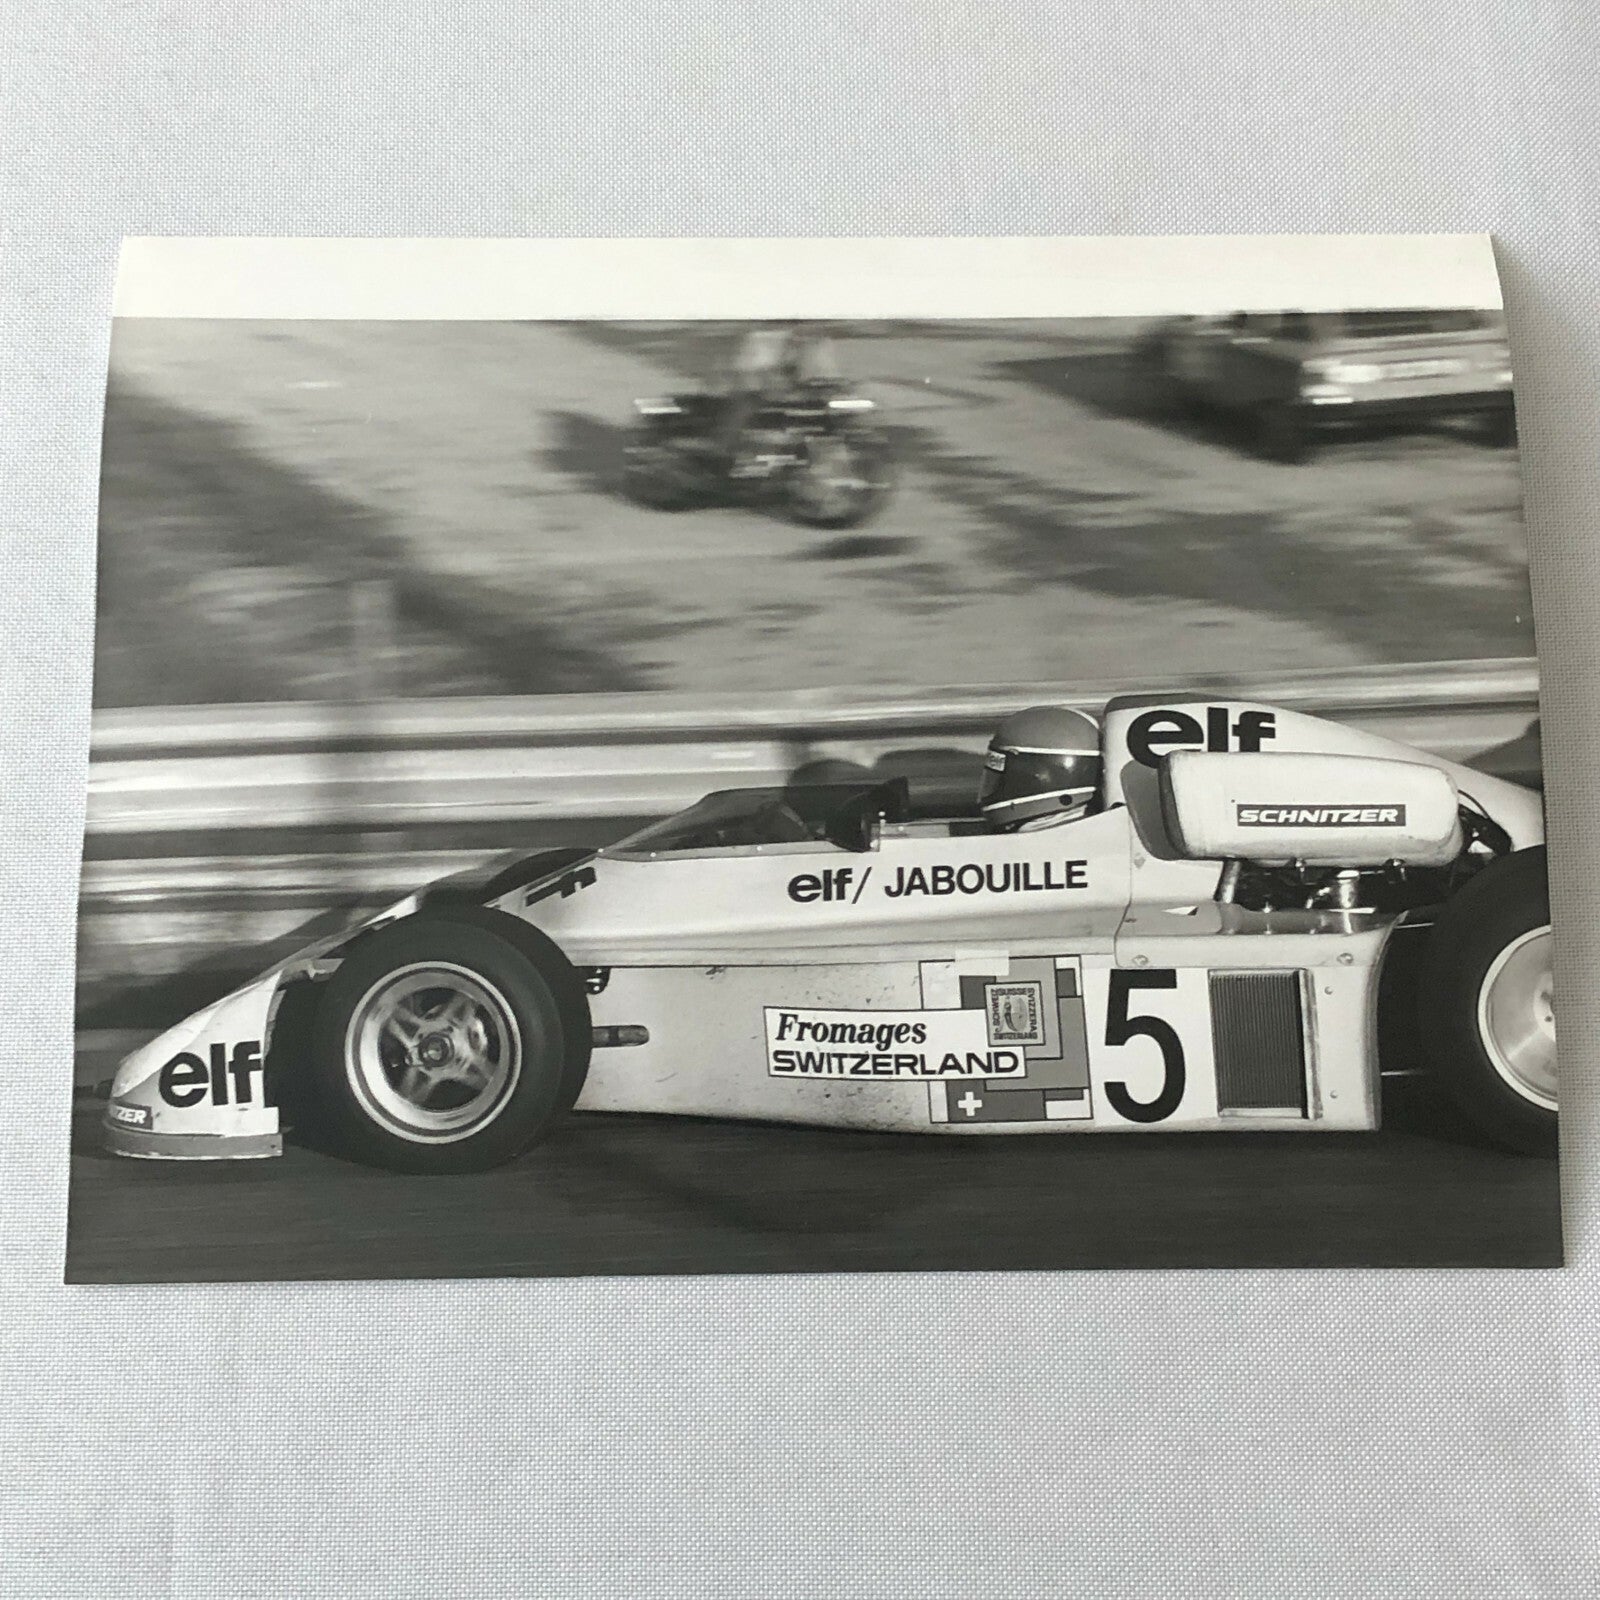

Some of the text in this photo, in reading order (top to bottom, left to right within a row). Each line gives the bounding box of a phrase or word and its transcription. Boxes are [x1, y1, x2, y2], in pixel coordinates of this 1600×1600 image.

[1126, 706, 1276, 769] elf
[1239, 808, 1398, 823] SCHNITZER
[884, 859, 1088, 898] JABOUILLE
[775, 1013, 927, 1051] Fromages
[1104, 968, 1186, 1124] 5
[158, 1040, 264, 1108] elf
[773, 1050, 1019, 1075] SWITZERLAND
